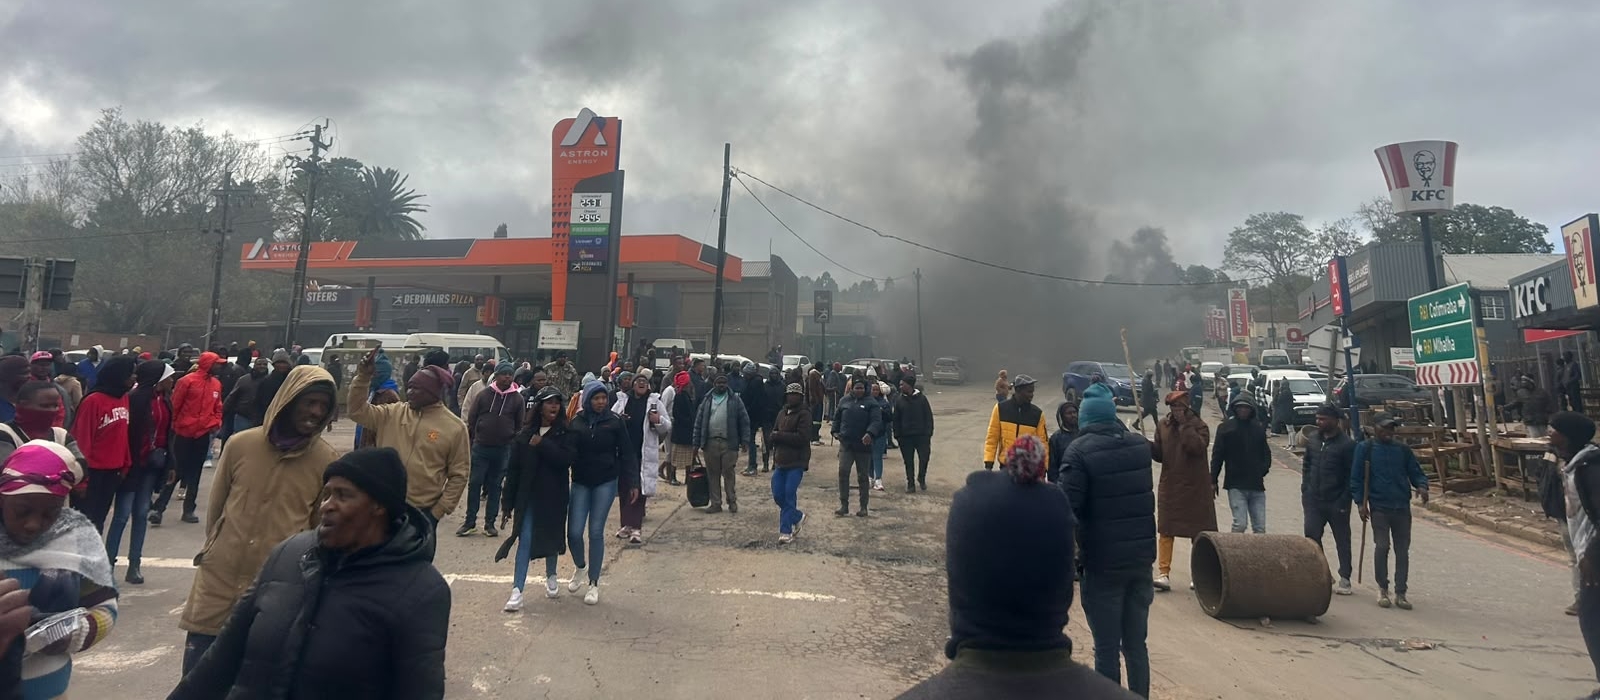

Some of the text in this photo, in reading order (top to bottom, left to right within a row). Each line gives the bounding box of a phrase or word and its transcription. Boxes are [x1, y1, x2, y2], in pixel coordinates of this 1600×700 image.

[559, 149, 608, 158] ASTRON
[1411, 189, 1446, 202] KFC
[579, 213, 602, 223] 2945
[306, 291, 338, 303] STEERS
[404, 293, 474, 305] DEBONAIRS PIZZA
[1513, 276, 1547, 319] KFC
[1429, 297, 1458, 319] Cofimvaba
[1433, 336, 1456, 353] Mthatha
